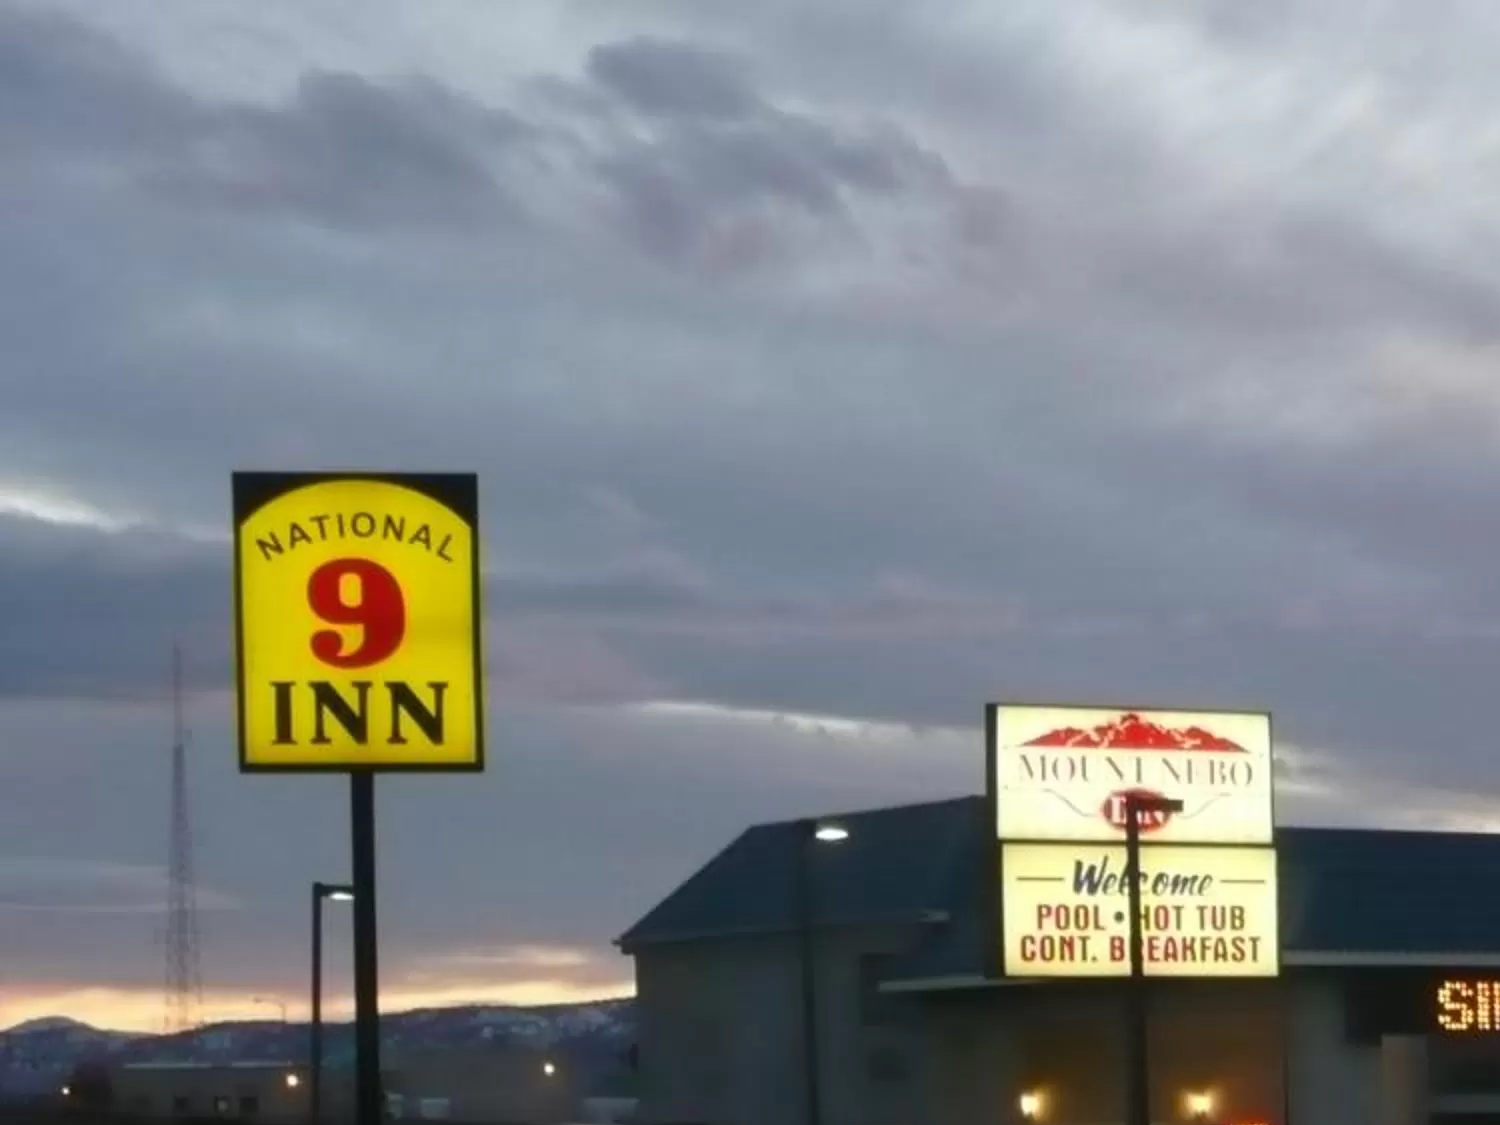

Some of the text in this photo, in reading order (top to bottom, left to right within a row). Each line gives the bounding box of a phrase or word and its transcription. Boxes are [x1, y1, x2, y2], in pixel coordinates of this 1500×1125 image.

[255, 511, 454, 563] NATIONAL
[306, 556, 406, 670] 9
[269, 681, 449, 745] INN
[1036, 904, 1106, 931] POOL
[1196, 905, 1246, 931] TUB
[1020, 935, 1262, 963] CONT. BEAKFAST
